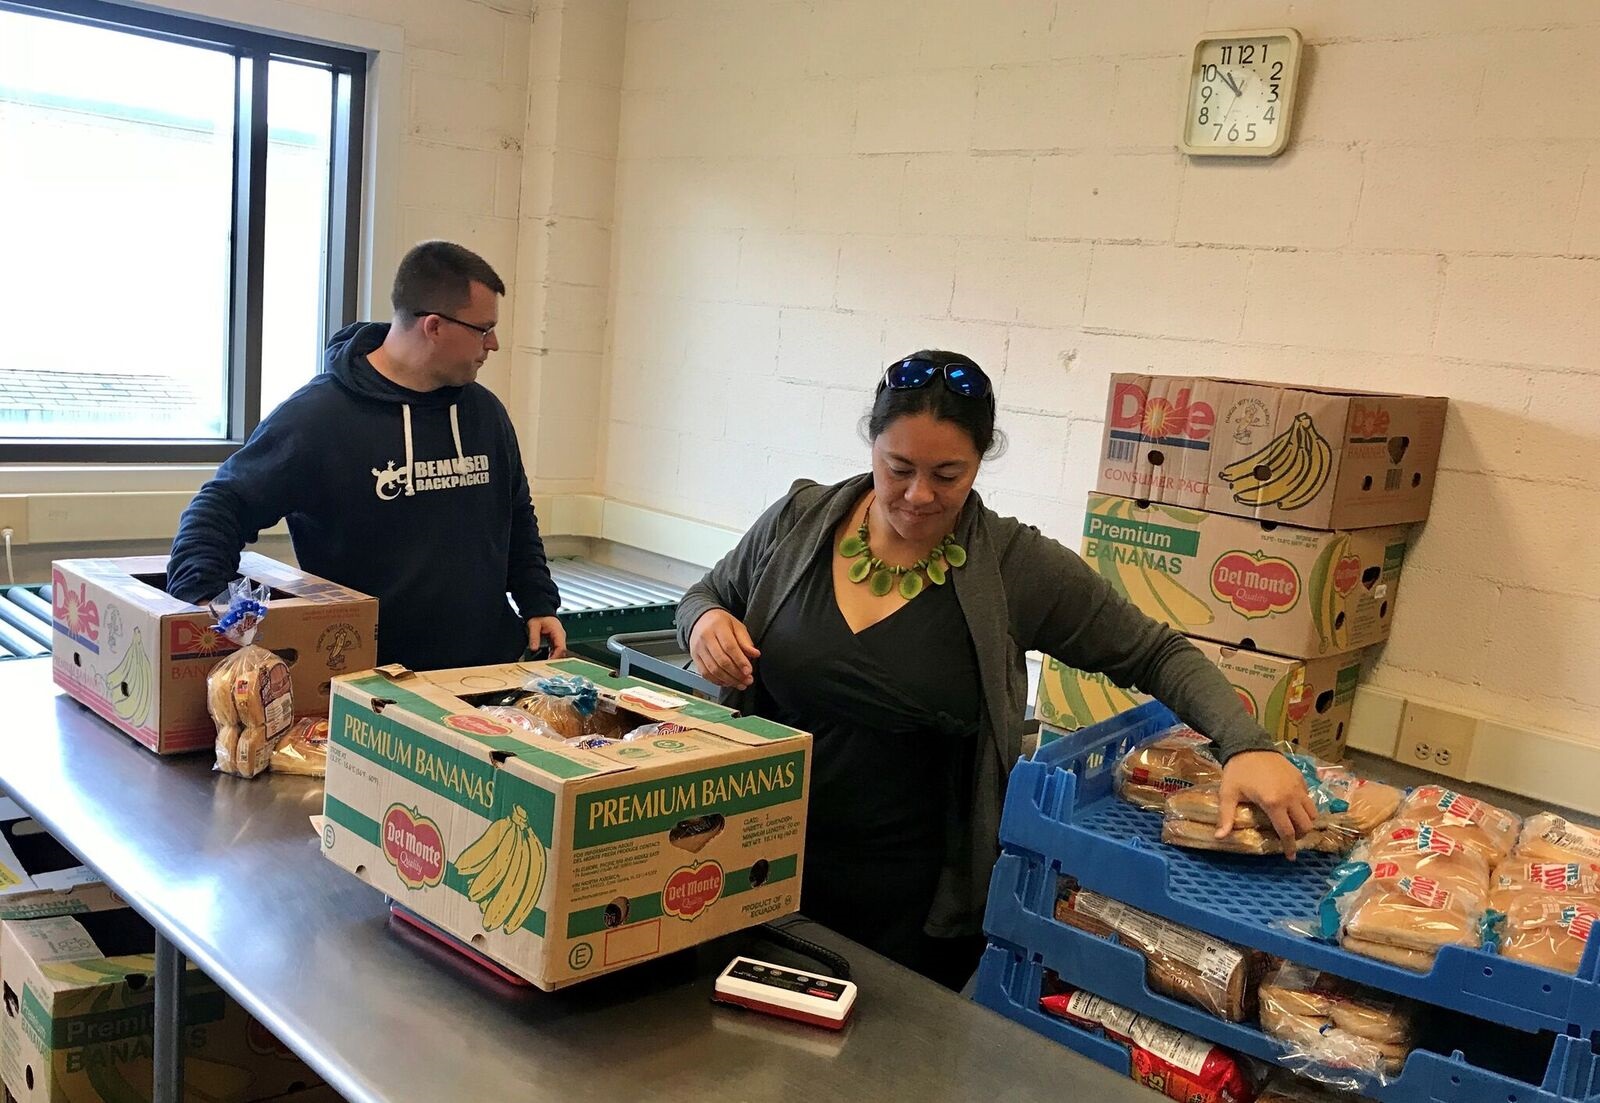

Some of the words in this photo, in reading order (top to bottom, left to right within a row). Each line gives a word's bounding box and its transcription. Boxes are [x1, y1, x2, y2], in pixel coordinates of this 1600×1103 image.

[1220, 46, 1232, 65] 11
[1238, 45, 1255, 65] 12
[1261, 44, 1268, 63] 1
[1201, 64, 1217, 82] 10
[1270, 61, 1283, 80] 2
[1201, 86, 1212, 104] 9
[1267, 84, 1279, 103] 3
[1198, 107, 1209, 125] 8
[1263, 106, 1275, 124] 4
[1213, 123, 1223, 141] 7
[1227, 124, 1239, 141] 6
[1245, 123, 1256, 141] 5
[1110, 382, 1216, 440] Dole
[415, 455, 490, 478] BEMUSED
[416, 471, 490, 491] BACKPACKER
[1105, 468, 1174, 489] CONSUMER
[1177, 479, 1211, 496] PACK
[1089, 518, 1171, 548] Premium
[1086, 541, 1183, 575] BANANAS
[1218, 566, 1242, 587] Del
[1244, 571, 1294, 596] Monte
[52, 568, 100, 642] Dole
[343, 713, 412, 769] PREMIUM
[415, 747, 496, 808] BANANAS
[588, 783, 696, 831] PREMIUM
[701, 761, 796, 808] BANANAS
[387, 821, 404, 849] Del
[405, 831, 441, 869] Monte
[669, 883, 686, 901] Del
[687, 876, 720, 897] Monte
[741, 897, 771, 913] PRODUCT
[750, 902, 782, 918] ECUADOR
